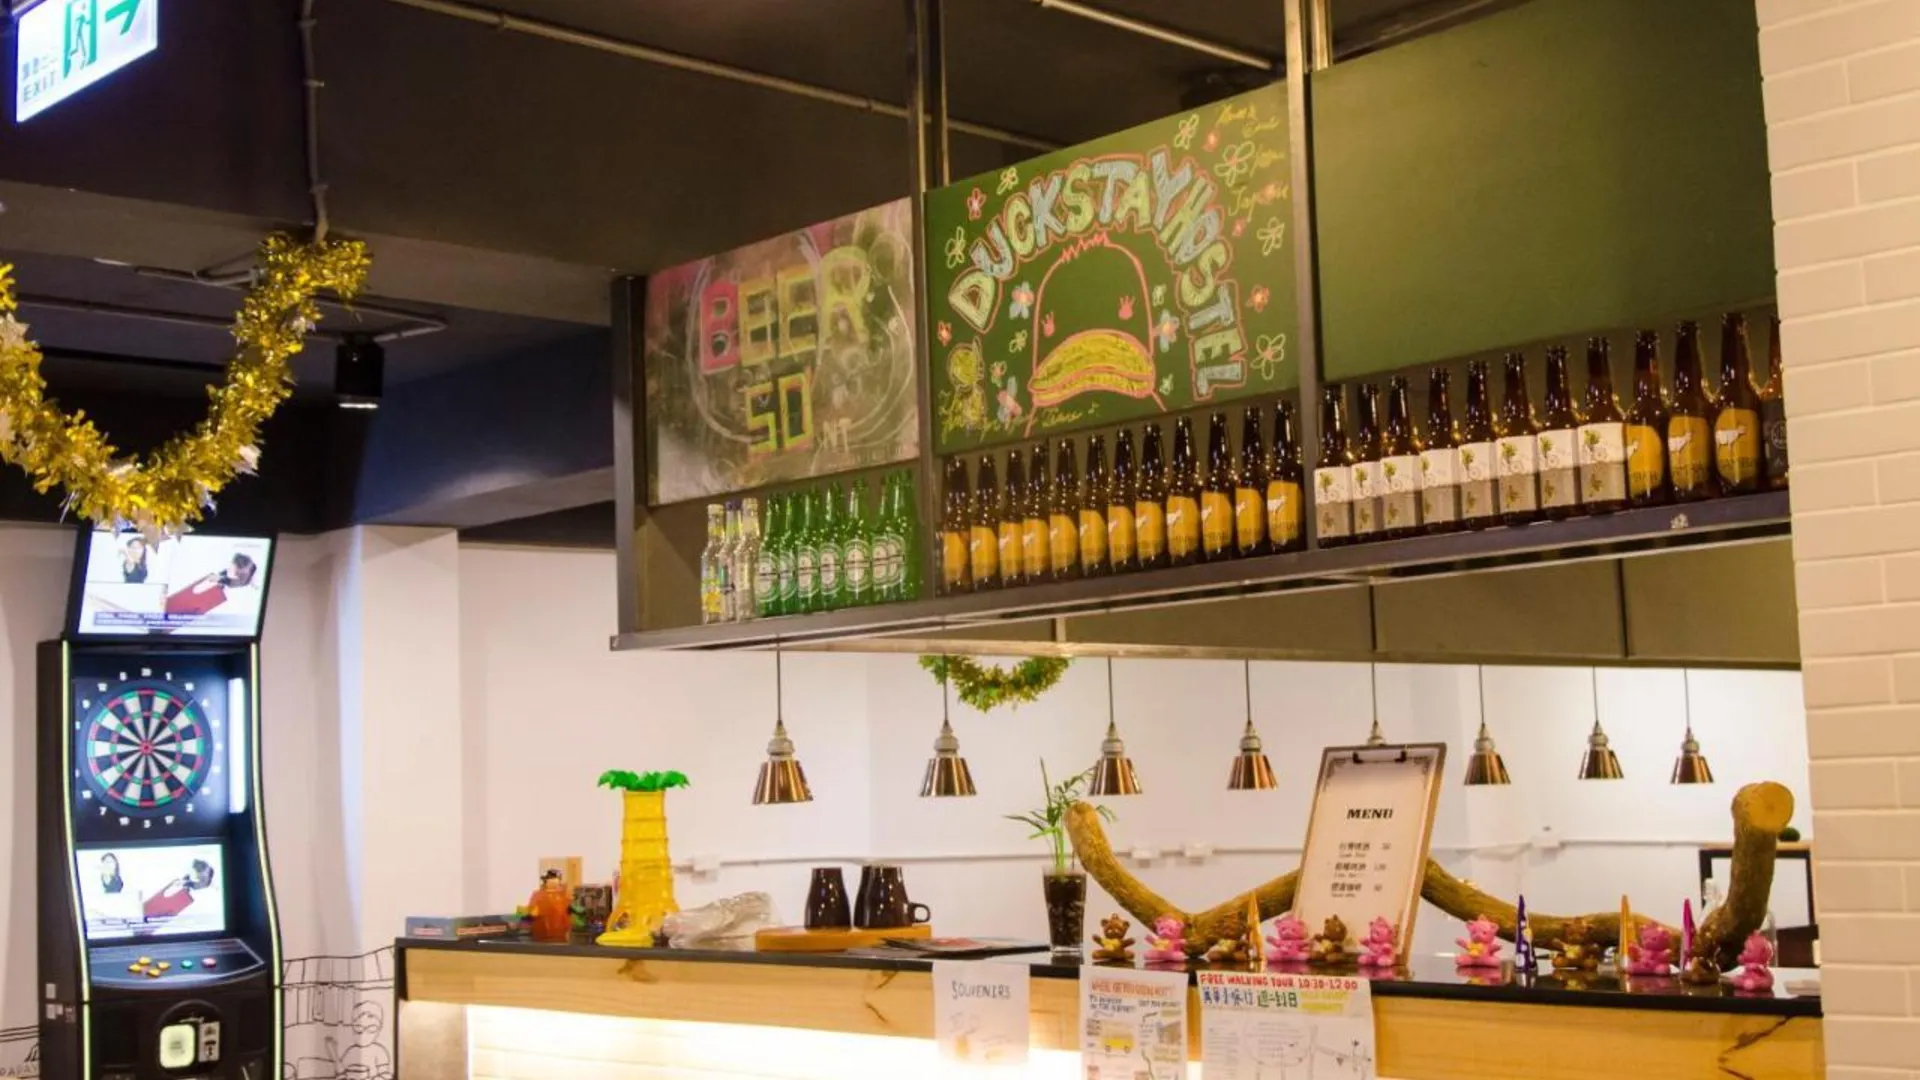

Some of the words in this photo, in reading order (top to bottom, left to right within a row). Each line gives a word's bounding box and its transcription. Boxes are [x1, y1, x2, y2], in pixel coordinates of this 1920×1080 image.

[23, 70, 55, 102] EXIT
[700, 246, 869, 374] BEER
[1346, 808, 1394, 820] MENU
[951, 980, 1011, 1000] SOUVENIRS
[1200, 973, 1224, 985] FREE
[1226, 975, 1269, 986] WALKING
[1270, 977, 1294, 988] TOUR
